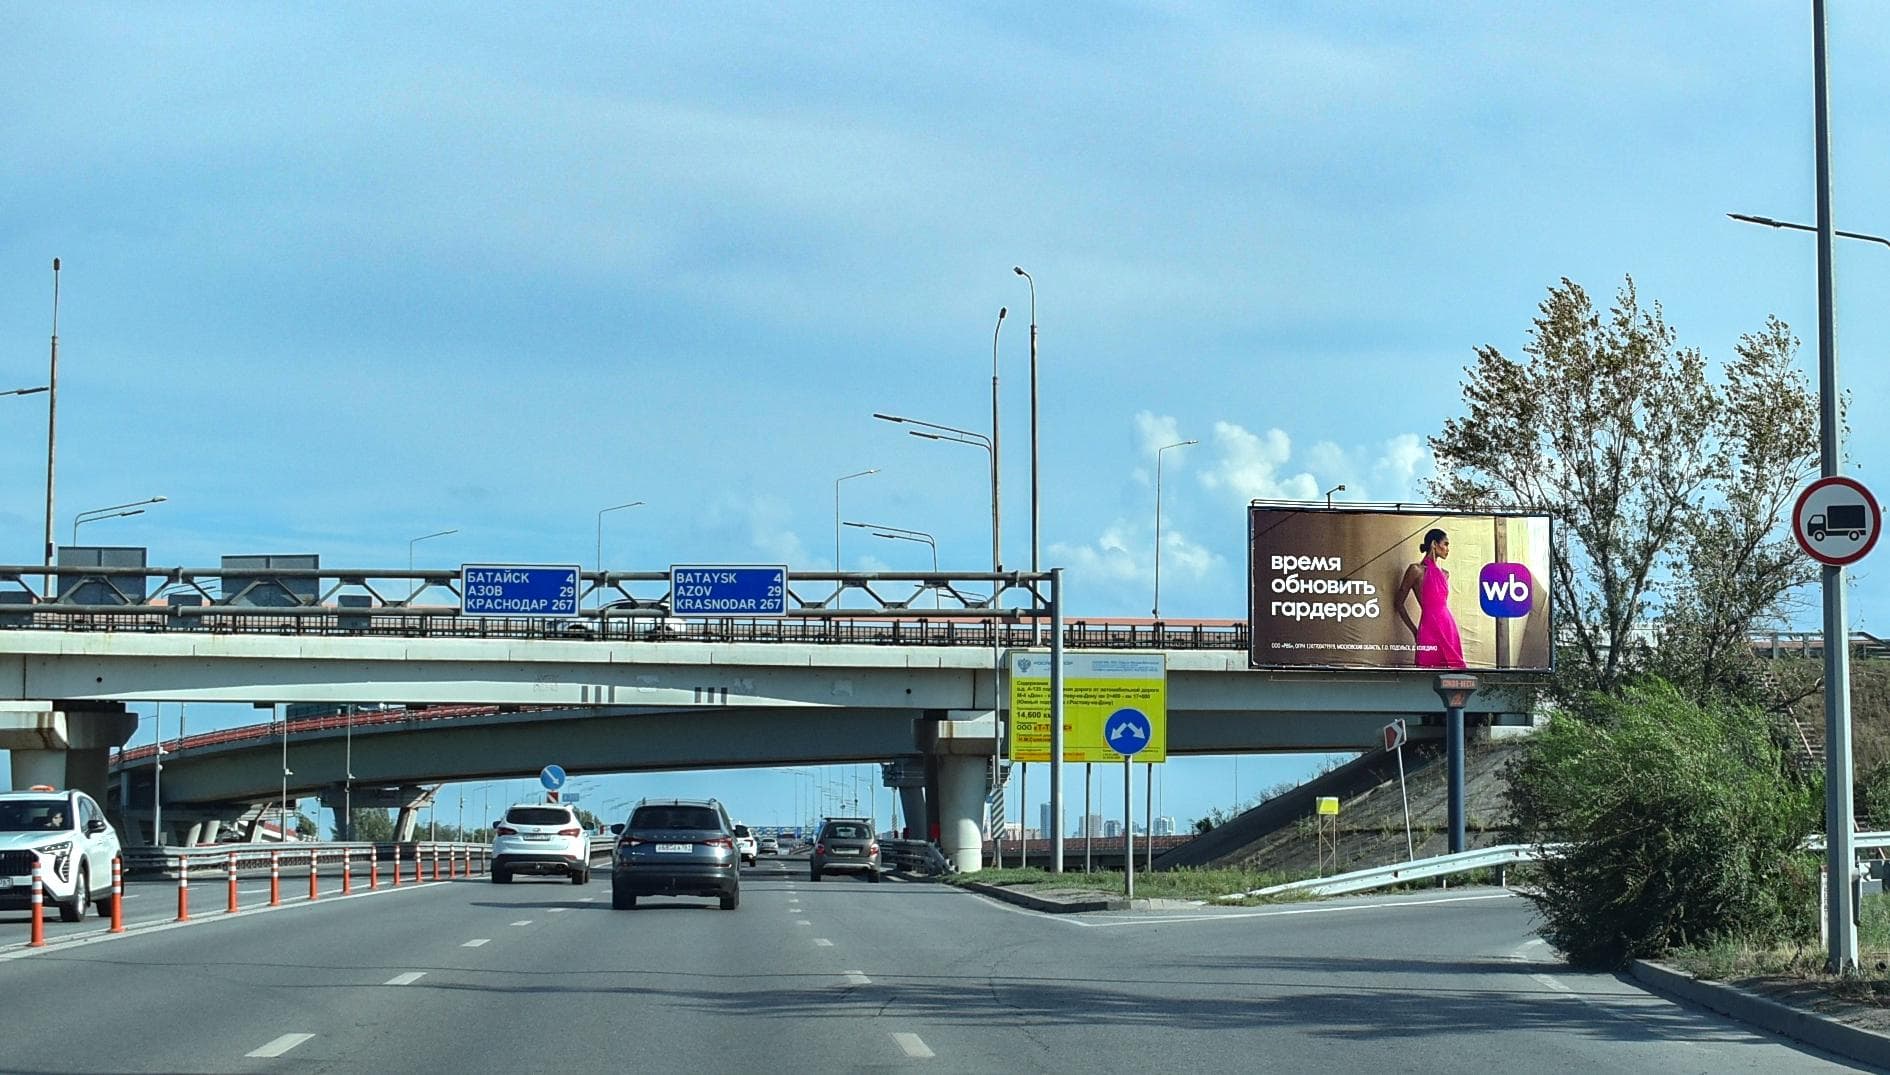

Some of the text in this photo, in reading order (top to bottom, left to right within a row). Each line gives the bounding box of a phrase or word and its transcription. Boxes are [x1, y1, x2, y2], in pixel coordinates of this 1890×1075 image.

[1271, 555, 1341, 575] время
[467, 569, 574, 584] БАТАЙСК 4
[676, 572, 781, 584] BATAYSK 4
[1271, 573, 1376, 595] обновить
[1482, 573, 1529, 602] wb
[467, 585, 574, 597] АЗОВ 29
[677, 585, 782, 597] AZOV 29
[467, 599, 574, 611] КРАСНОДАР 267
[676, 599, 781, 610] KRASNODAR 267
[1271, 598, 1380, 622] гардероб
